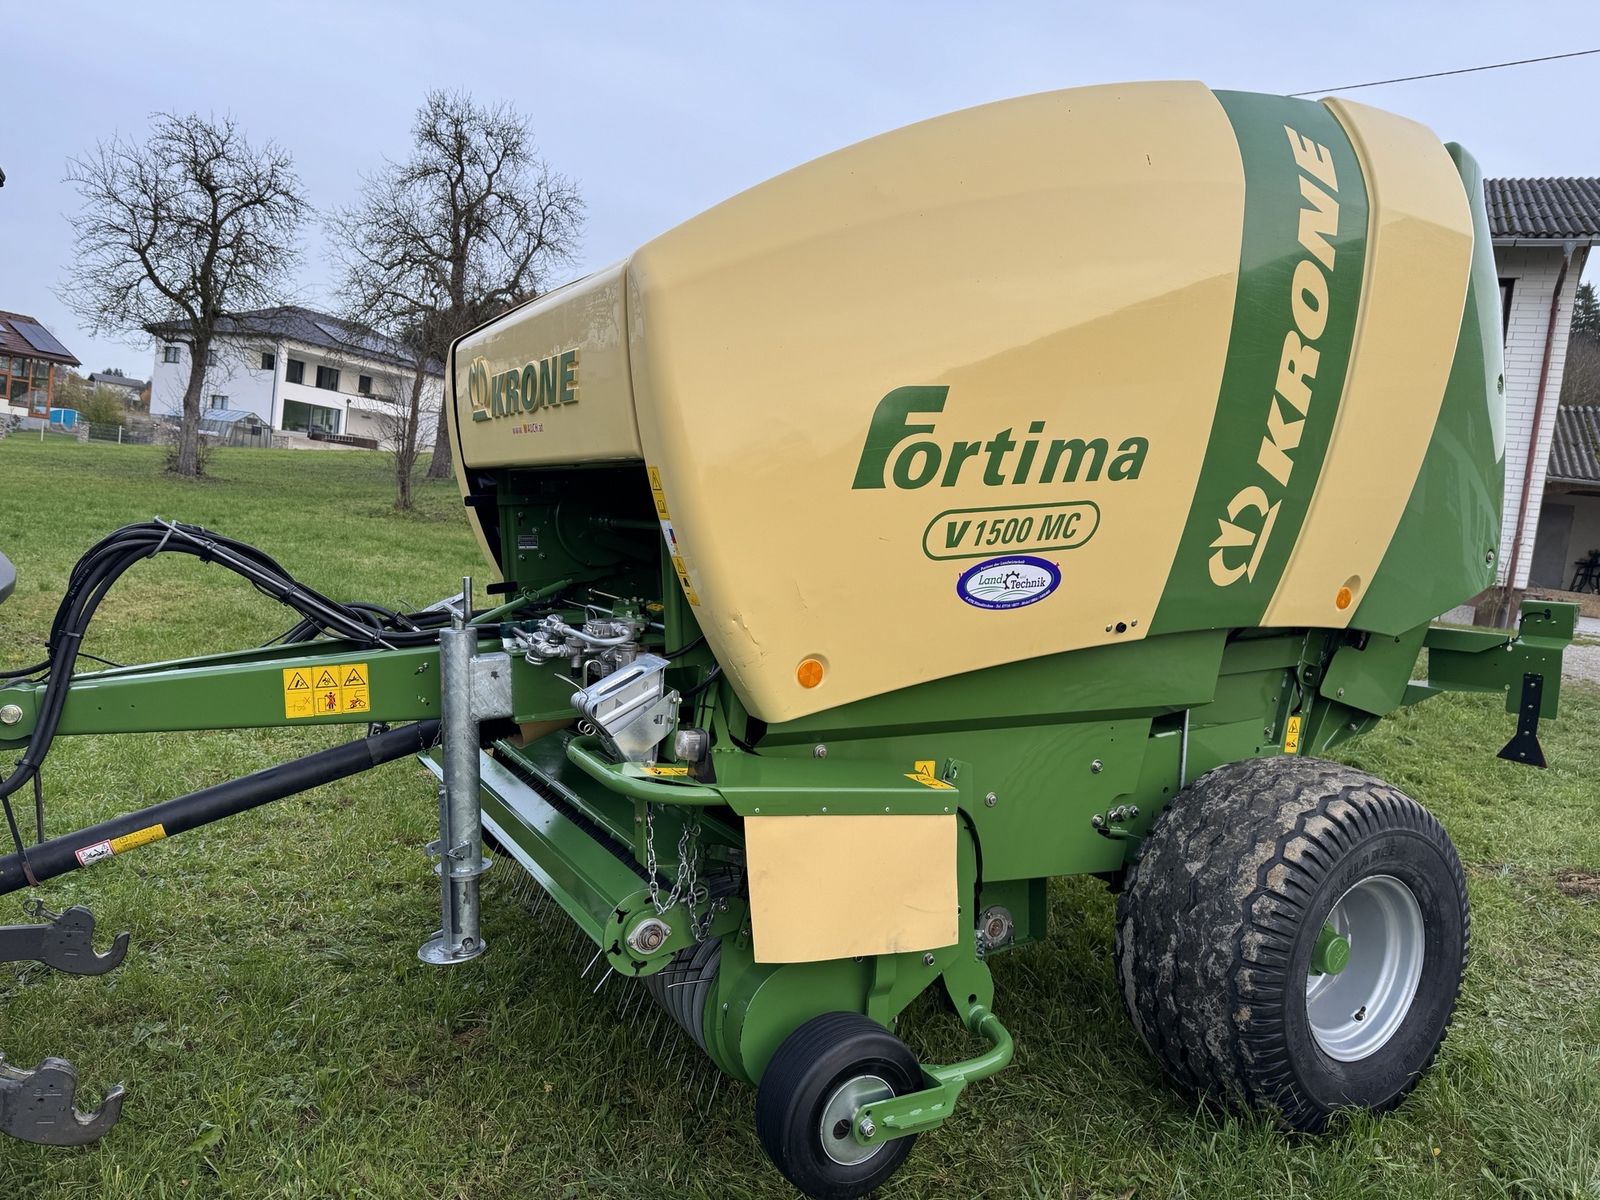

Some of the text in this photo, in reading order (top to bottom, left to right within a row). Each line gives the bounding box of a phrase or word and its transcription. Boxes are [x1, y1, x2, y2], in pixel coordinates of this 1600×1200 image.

[1257, 124, 1339, 487] KRONE
[491, 347, 579, 419] KRONE
[851, 385, 1149, 490] Fortima
[945, 512, 1082, 549] V 1500 MC
[978, 573, 1004, 585] Land
[1011, 577, 1046, 589] Technik
